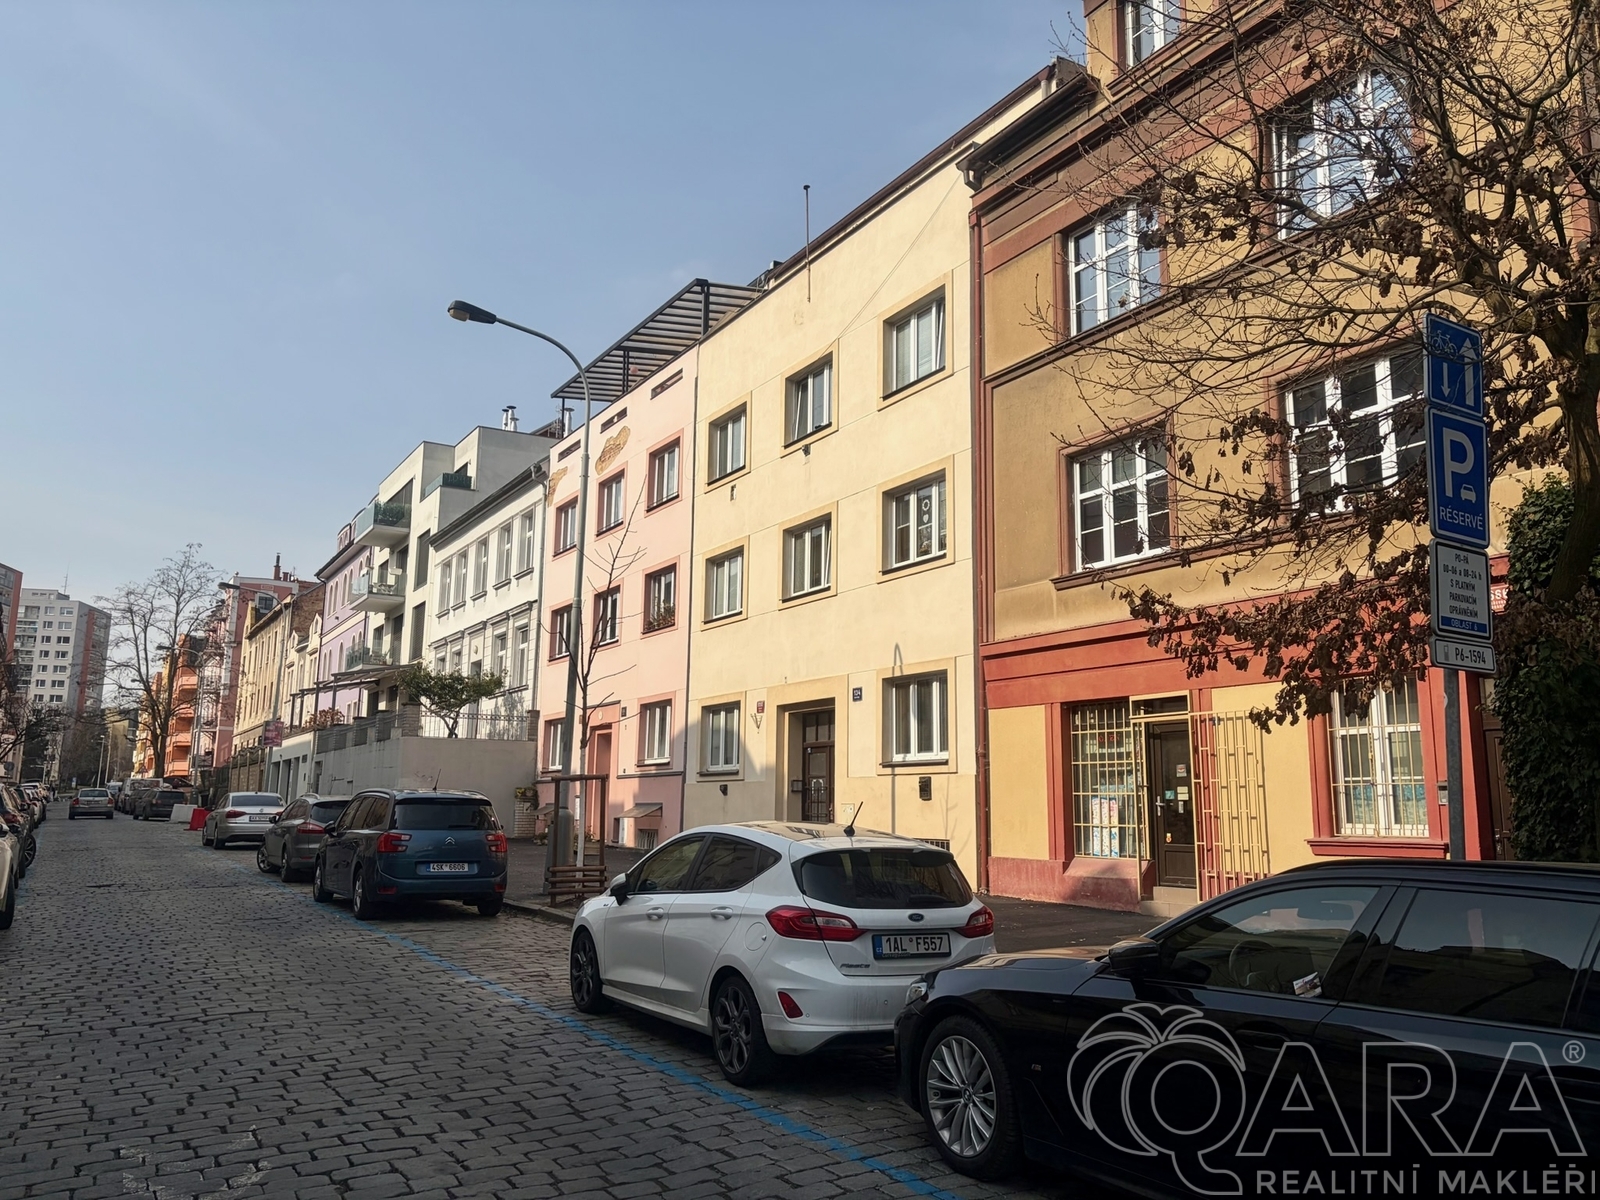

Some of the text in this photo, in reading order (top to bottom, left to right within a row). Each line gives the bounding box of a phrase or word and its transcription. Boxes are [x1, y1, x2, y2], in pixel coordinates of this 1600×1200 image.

[1443, 427, 1474, 497] P
[1440, 506, 1483, 530] RÉSERVÉ
[1455, 553, 1469, 564] PO-PÁ
[1450, 578, 1475, 593] S PLATNÝM
[1449, 592, 1477, 605] PARKOVACÍM
[1449, 605, 1478, 618] OPRÁVNĚNÍM
[1451, 619, 1478, 631] OBLAST 6
[1455, 647, 1486, 665] P6-1594
[432, 863, 444, 871] 4SK
[886, 936, 943, 952] 1AL F557
